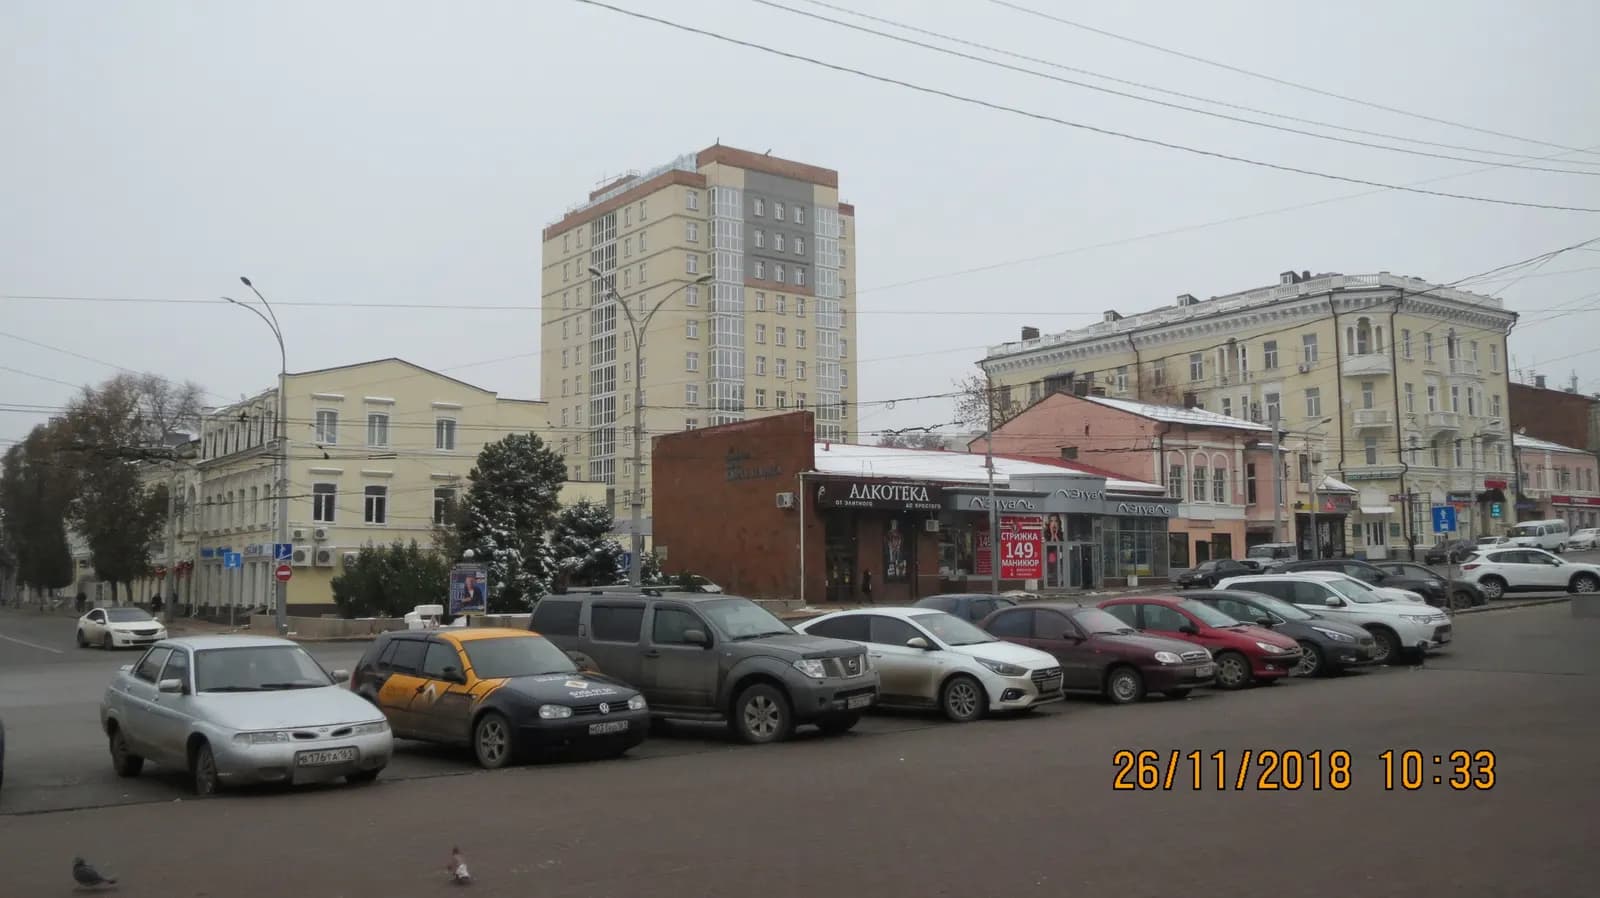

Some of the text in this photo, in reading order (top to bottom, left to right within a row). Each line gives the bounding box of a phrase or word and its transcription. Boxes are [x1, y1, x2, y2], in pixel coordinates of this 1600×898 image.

[849, 483, 930, 501] АЛКОТЕКА
[1001, 532, 1039, 541] СТРИЖКА
[1001, 559, 1040, 568] МАНИКЮР
